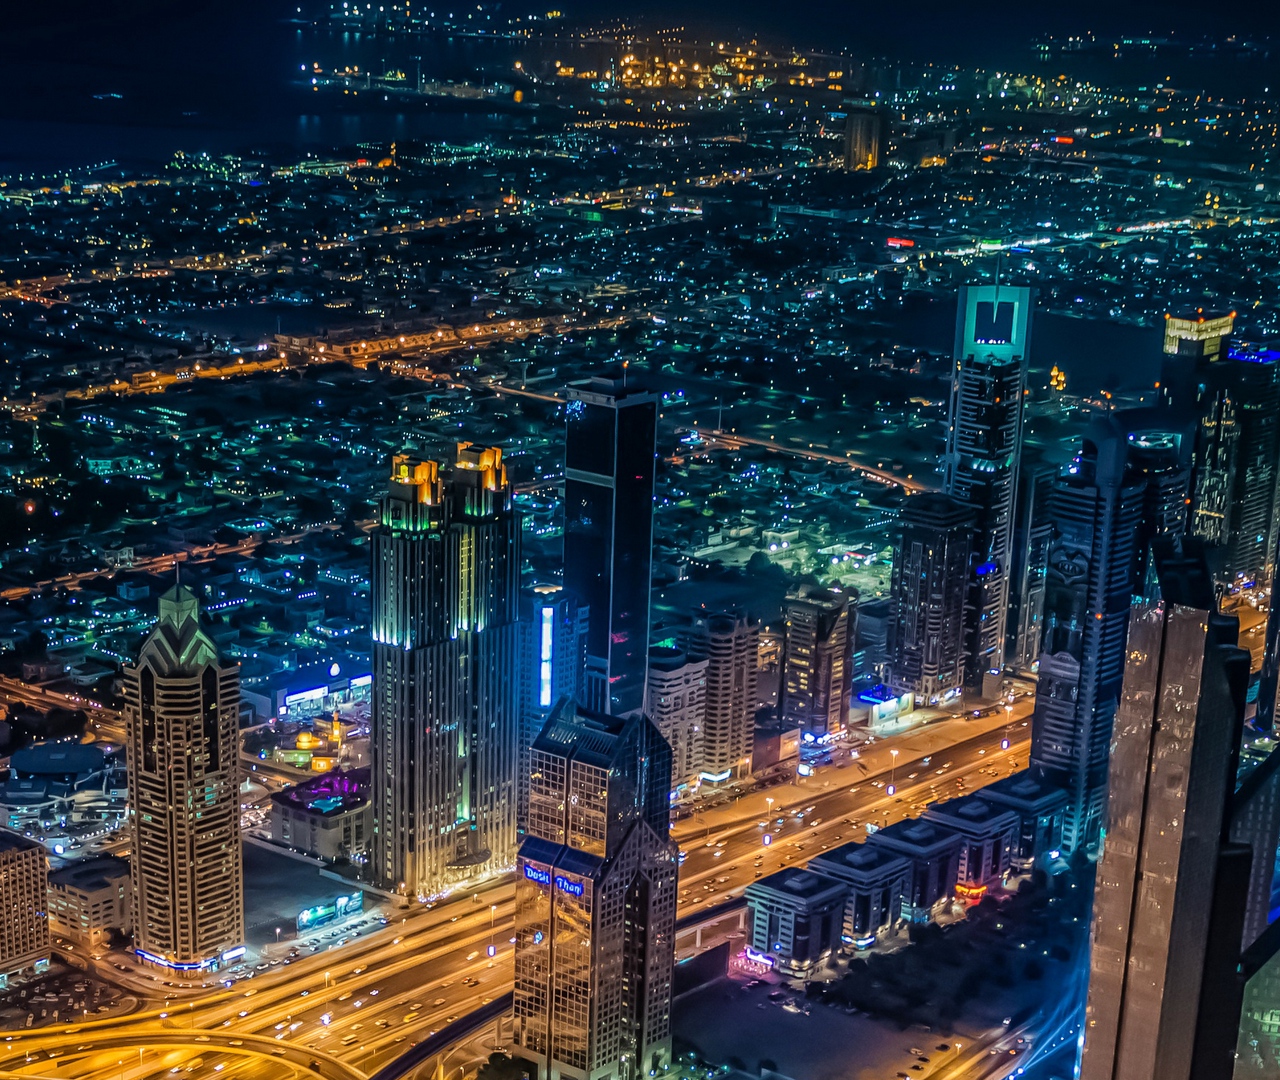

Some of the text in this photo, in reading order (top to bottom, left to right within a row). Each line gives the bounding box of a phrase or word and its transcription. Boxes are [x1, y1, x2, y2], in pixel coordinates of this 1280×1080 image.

[1060, 562, 1077, 575] KIA
[526, 867, 582, 896] Dusit Thani
